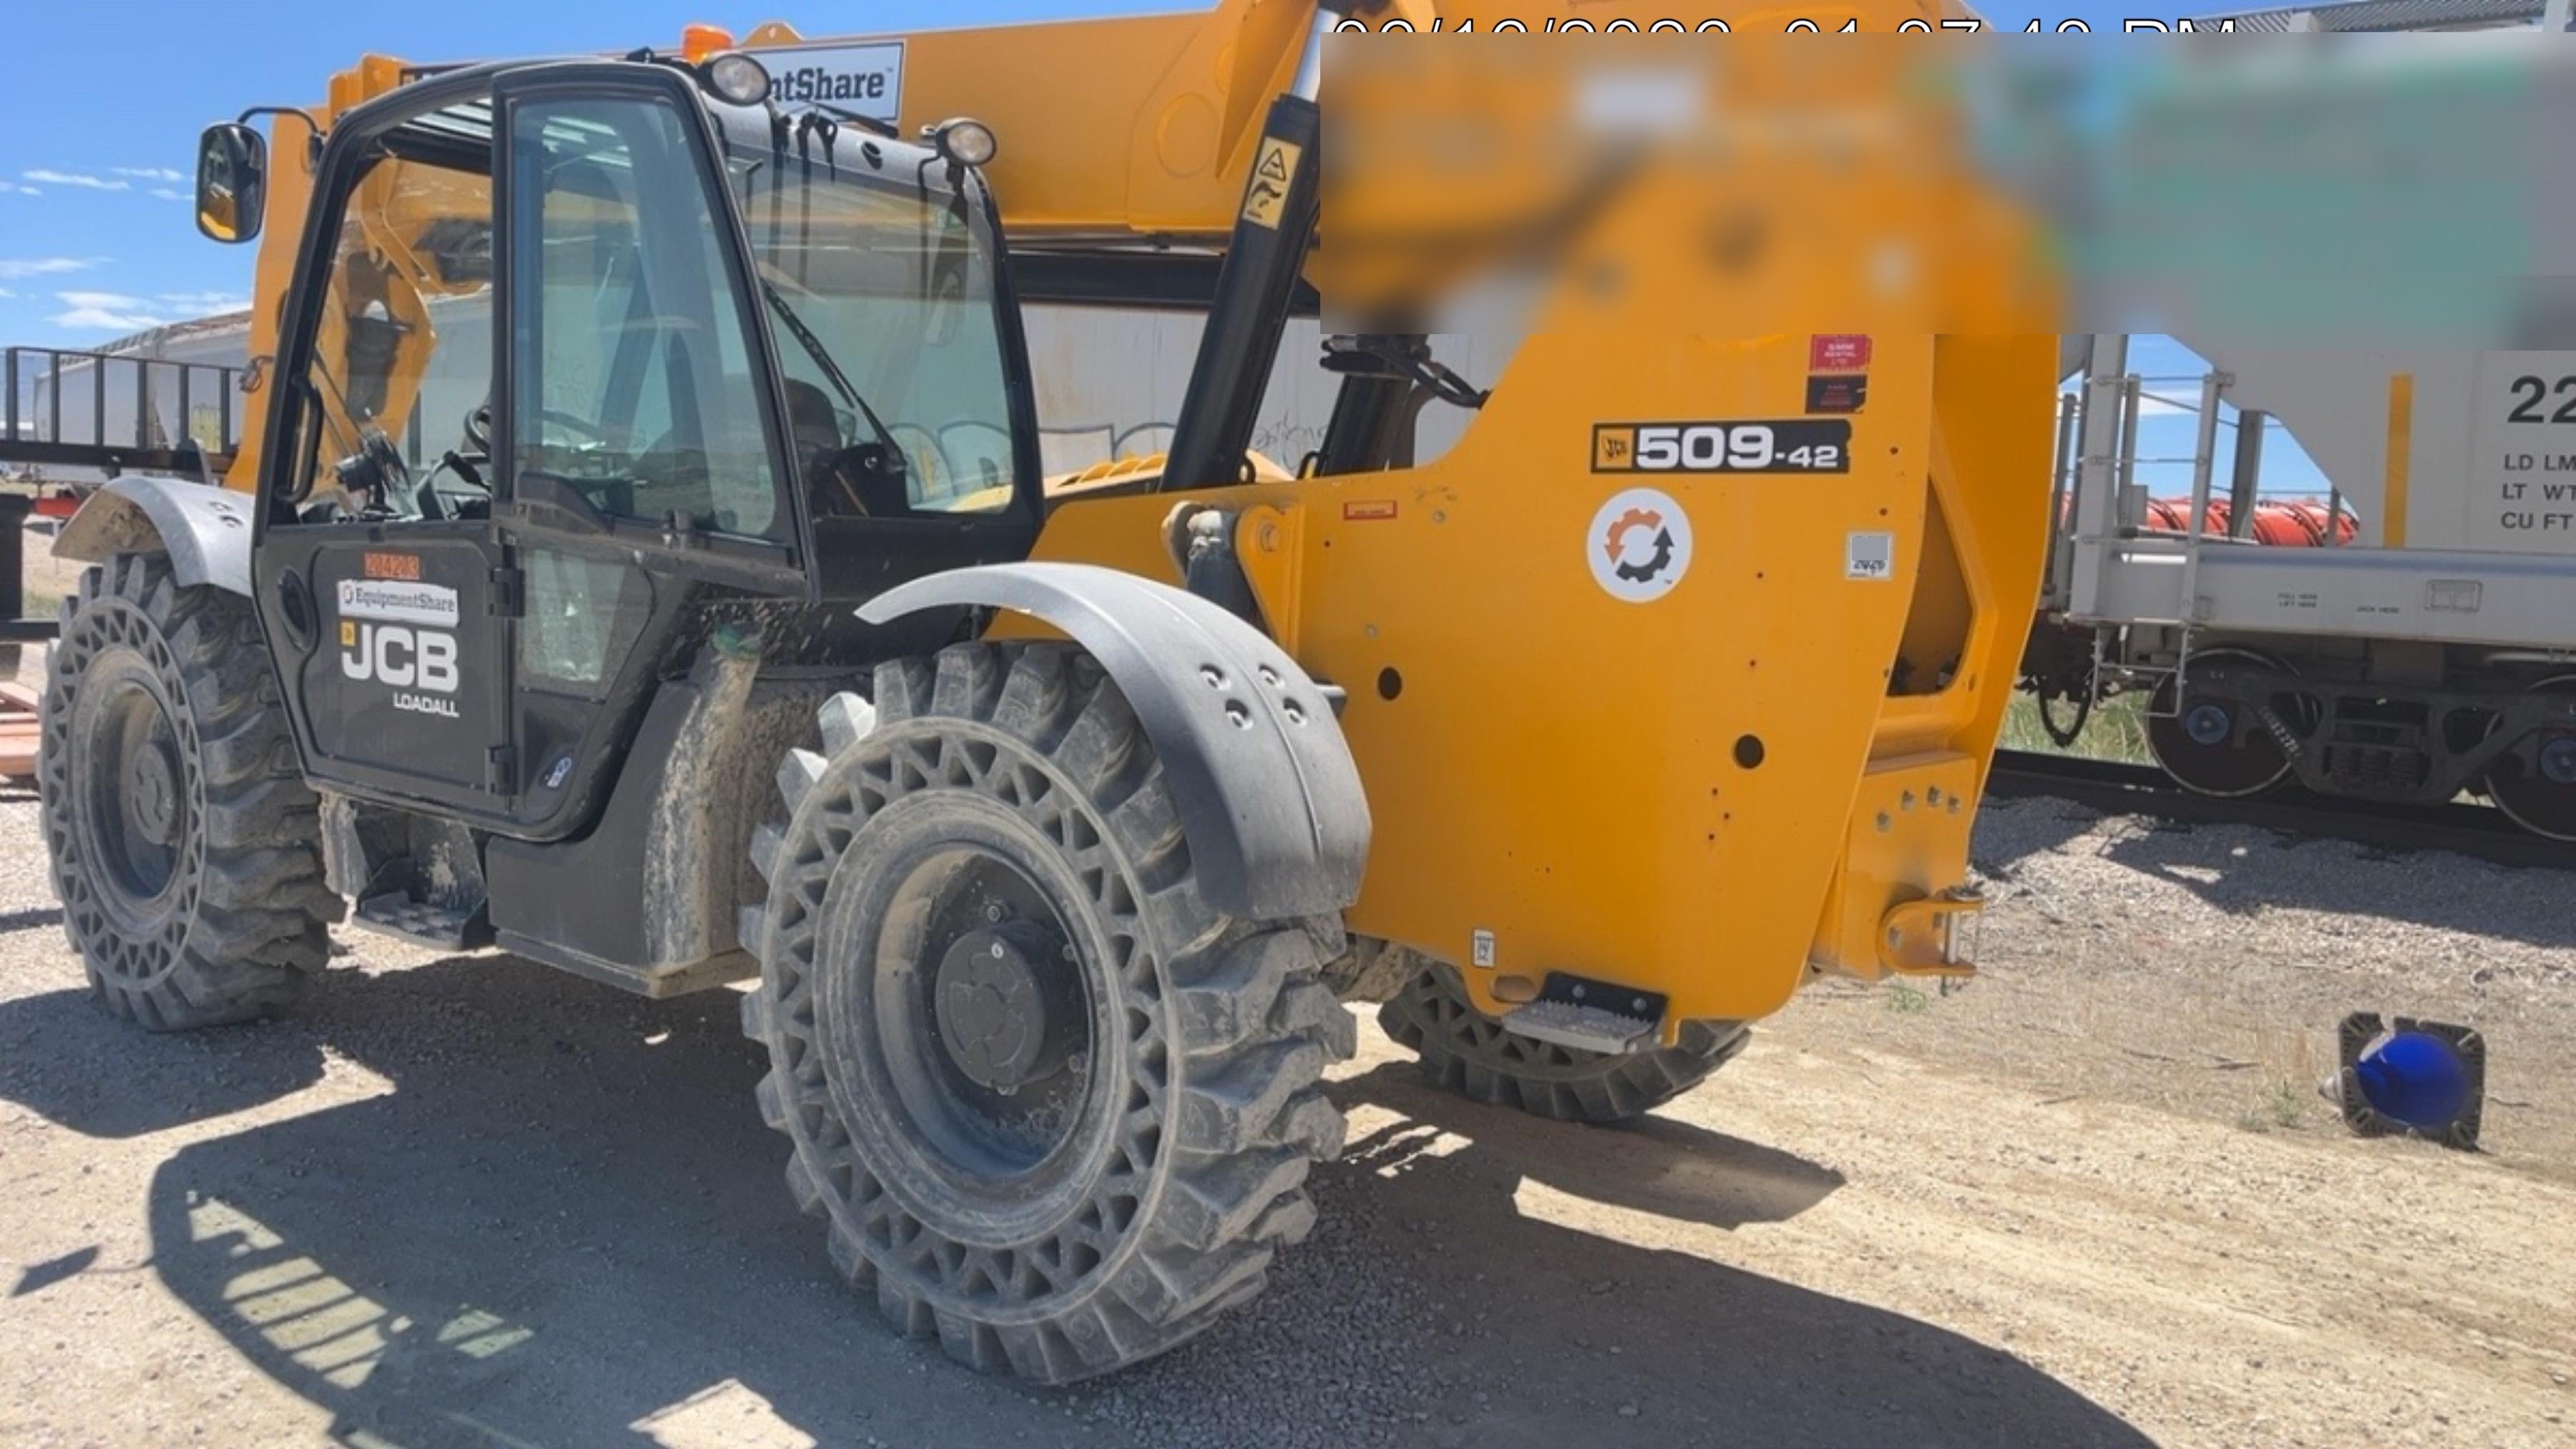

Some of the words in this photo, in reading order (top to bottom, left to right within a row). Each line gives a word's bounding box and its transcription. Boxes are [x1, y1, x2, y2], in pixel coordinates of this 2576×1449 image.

[2507, 375, 2576, 423] 22
[1636, 426, 1838, 469] 509-42
[2504, 454, 2534, 471] LD
[2502, 483, 2527, 499] LT
[2501, 511, 2534, 530] CU
[2544, 513, 2574, 530] FT
[356, 588, 455, 613] EquipmentShare
[341, 623, 459, 693] JCB
[394, 692, 460, 718] LOADALL
